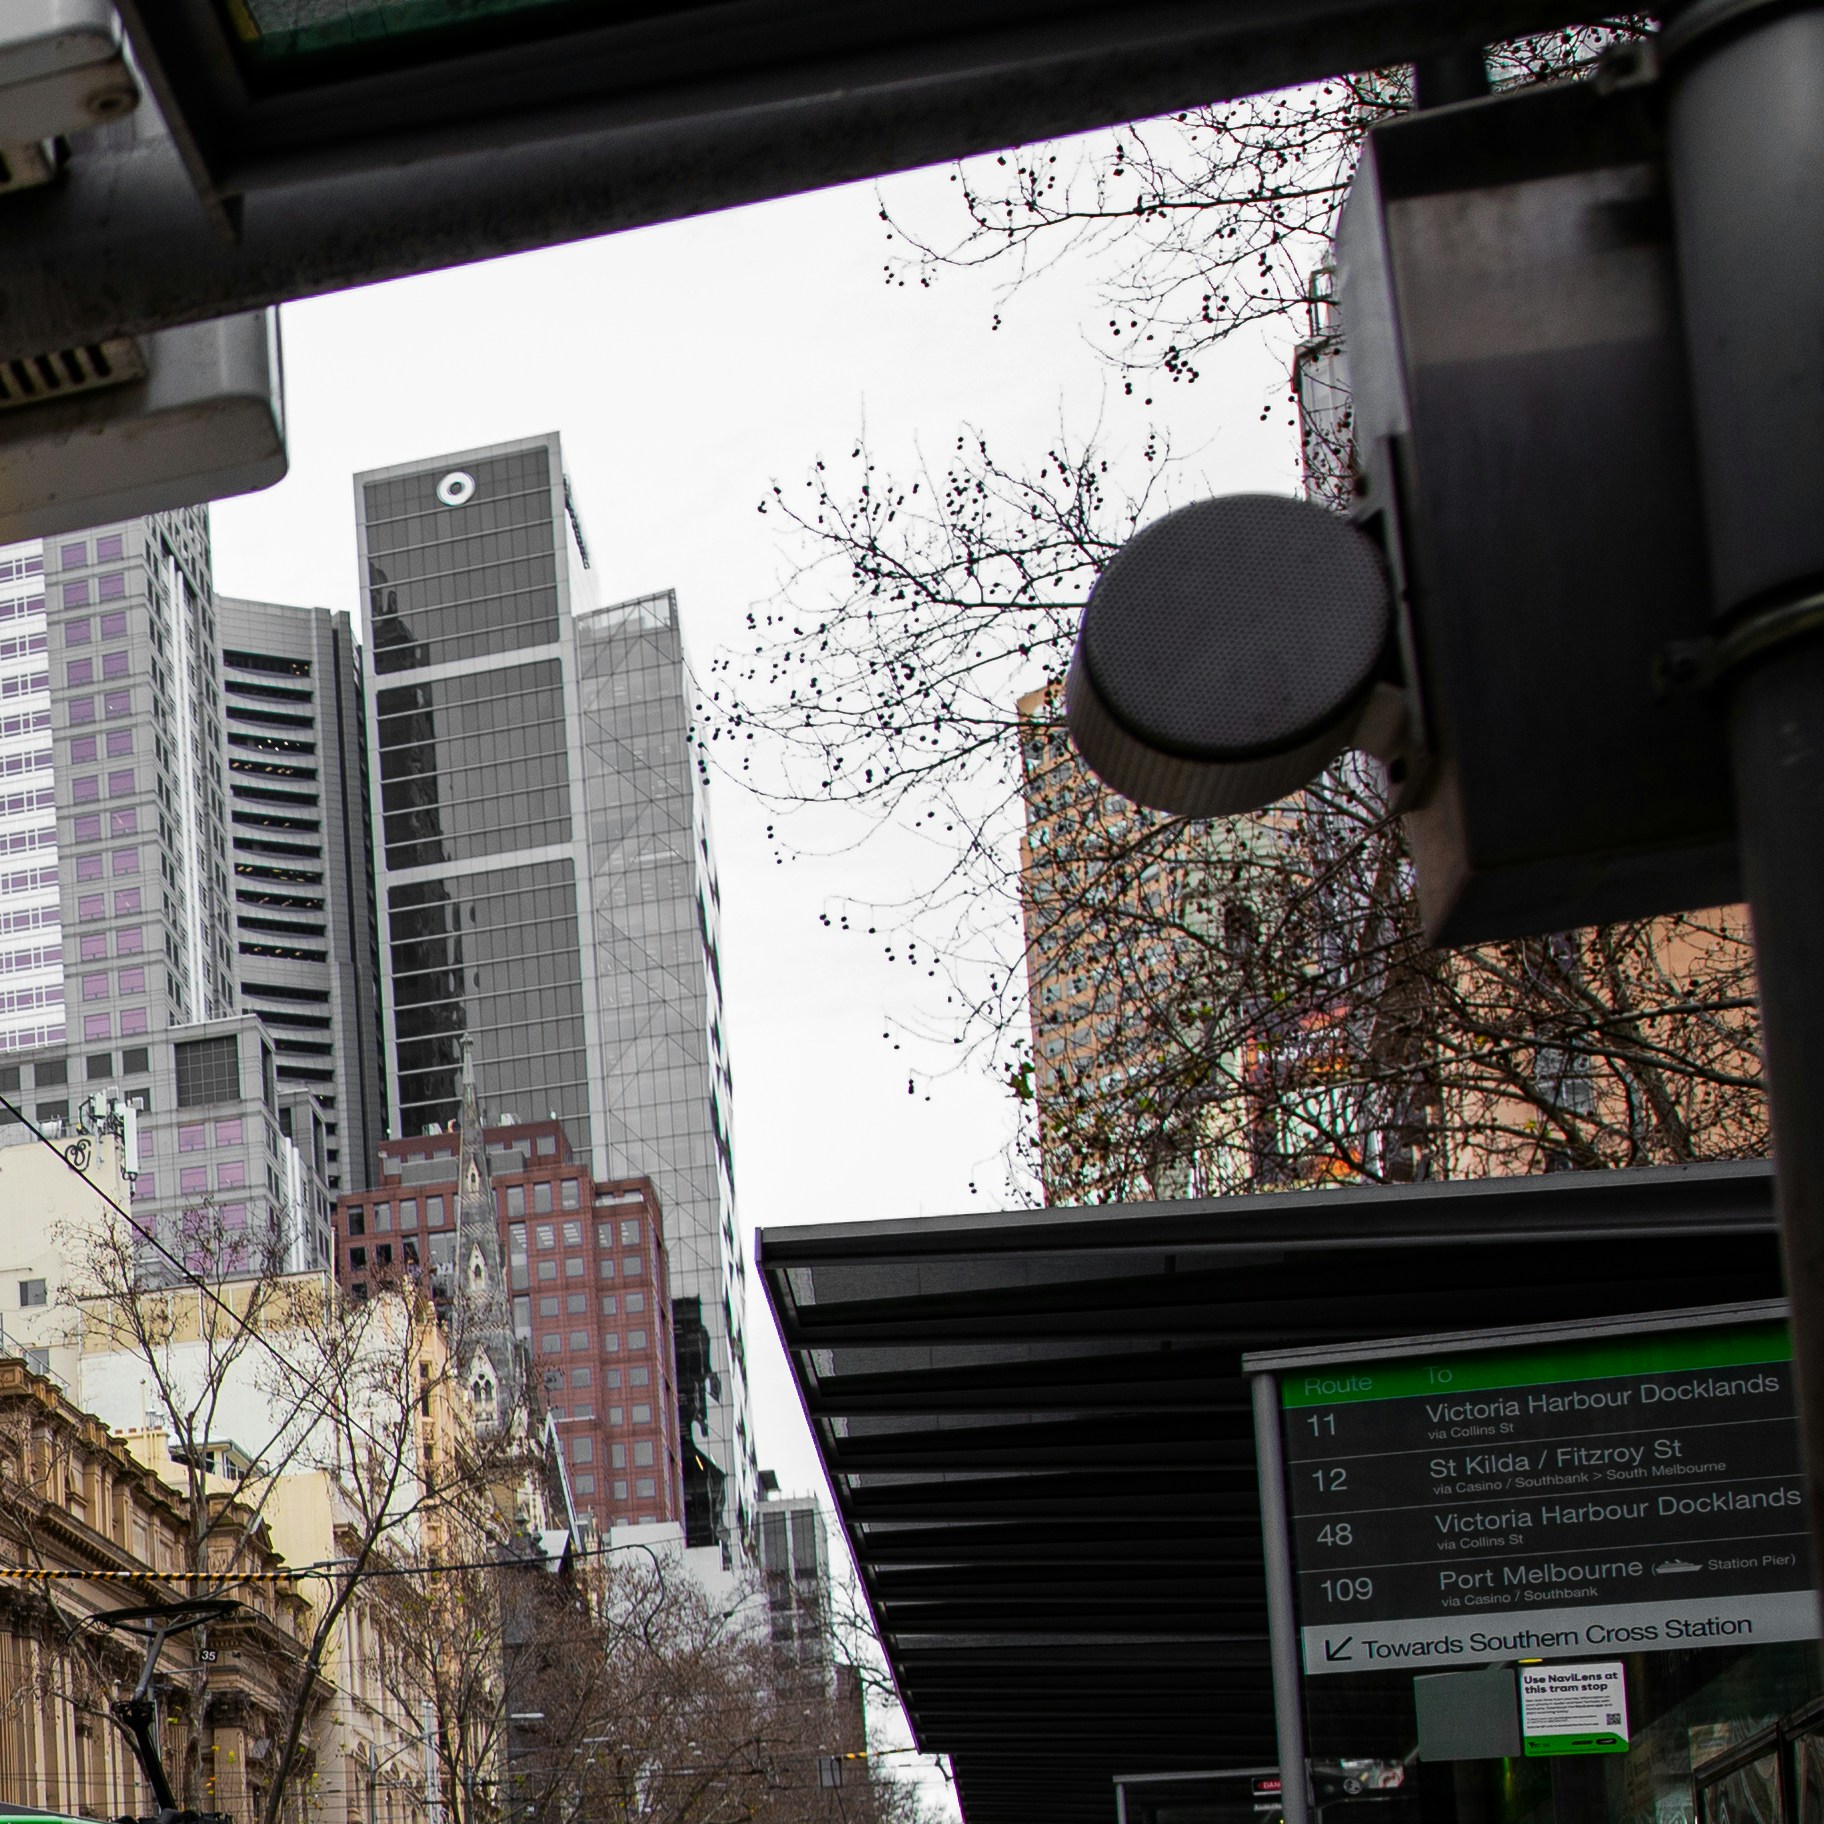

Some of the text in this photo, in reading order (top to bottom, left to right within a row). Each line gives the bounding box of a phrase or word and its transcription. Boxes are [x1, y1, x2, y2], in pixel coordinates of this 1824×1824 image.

[1304, 1365, 1453, 1397] Route To
[1425, 1373, 1780, 1423] Victoria Harbour Docklands
[1307, 1413, 1336, 1437] 11
[1428, 1423, 1514, 1440] via Collins St
[1429, 1458, 1457, 1479] St
[1467, 1453, 1530, 1475] Kilda
[1557, 1445, 1645, 1468] Fitzroy
[1654, 1439, 1683, 1459] St
[1312, 1467, 1348, 1492] 12
[1433, 1485, 1452, 1495] via
[1456, 1480, 1502, 1493] Casino
[1515, 1472, 1589, 1489] Southbank
[1607, 1467, 1648, 1480] South
[1652, 1460, 1727, 1477] Melbourne
[1435, 1487, 1802, 1534] Victoria Harbour Docklands
[1316, 1523, 1353, 1547] 48
[1437, 1534, 1524, 1551] via Collins St
[1439, 1553, 1796, 1591] Port Melbourne Station Pier)
[1320, 1577, 1373, 1603] 109
[1440, 1596, 1459, 1608] via
[1463, 1592, 1511, 1606] Casino
[1524, 1586, 1598, 1601] Southbank
[1363, 1615, 1753, 1660] Towards Southern Cross Station
[202, 1650, 216, 1660] 35
[1524, 1672, 1618, 1684] Use NaviLens at
[1525, 1683, 1608, 1693] this tram stop
